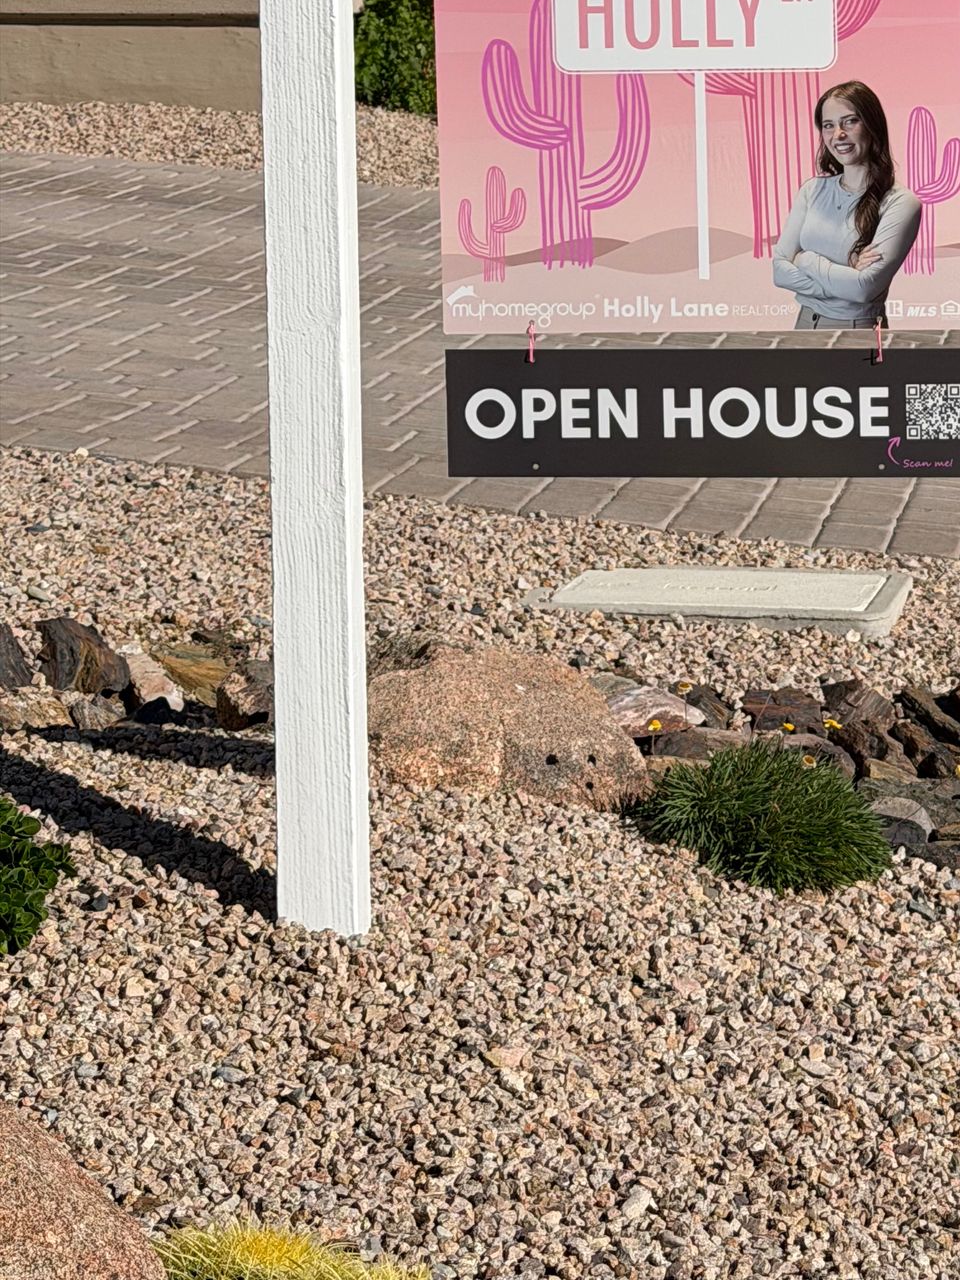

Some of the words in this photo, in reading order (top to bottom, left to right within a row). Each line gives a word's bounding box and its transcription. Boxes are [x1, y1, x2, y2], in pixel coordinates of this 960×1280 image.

[452, 299, 596, 328] myhomegroup
[603, 296, 664, 323] Holly
[670, 297, 729, 317] Lane
[906, 305, 938, 318] MLS
[464, 388, 639, 440] OPEN
[662, 386, 891, 439] HOUSE
[903, 458, 932, 469] Scan
[934, 458, 954, 469] me!
